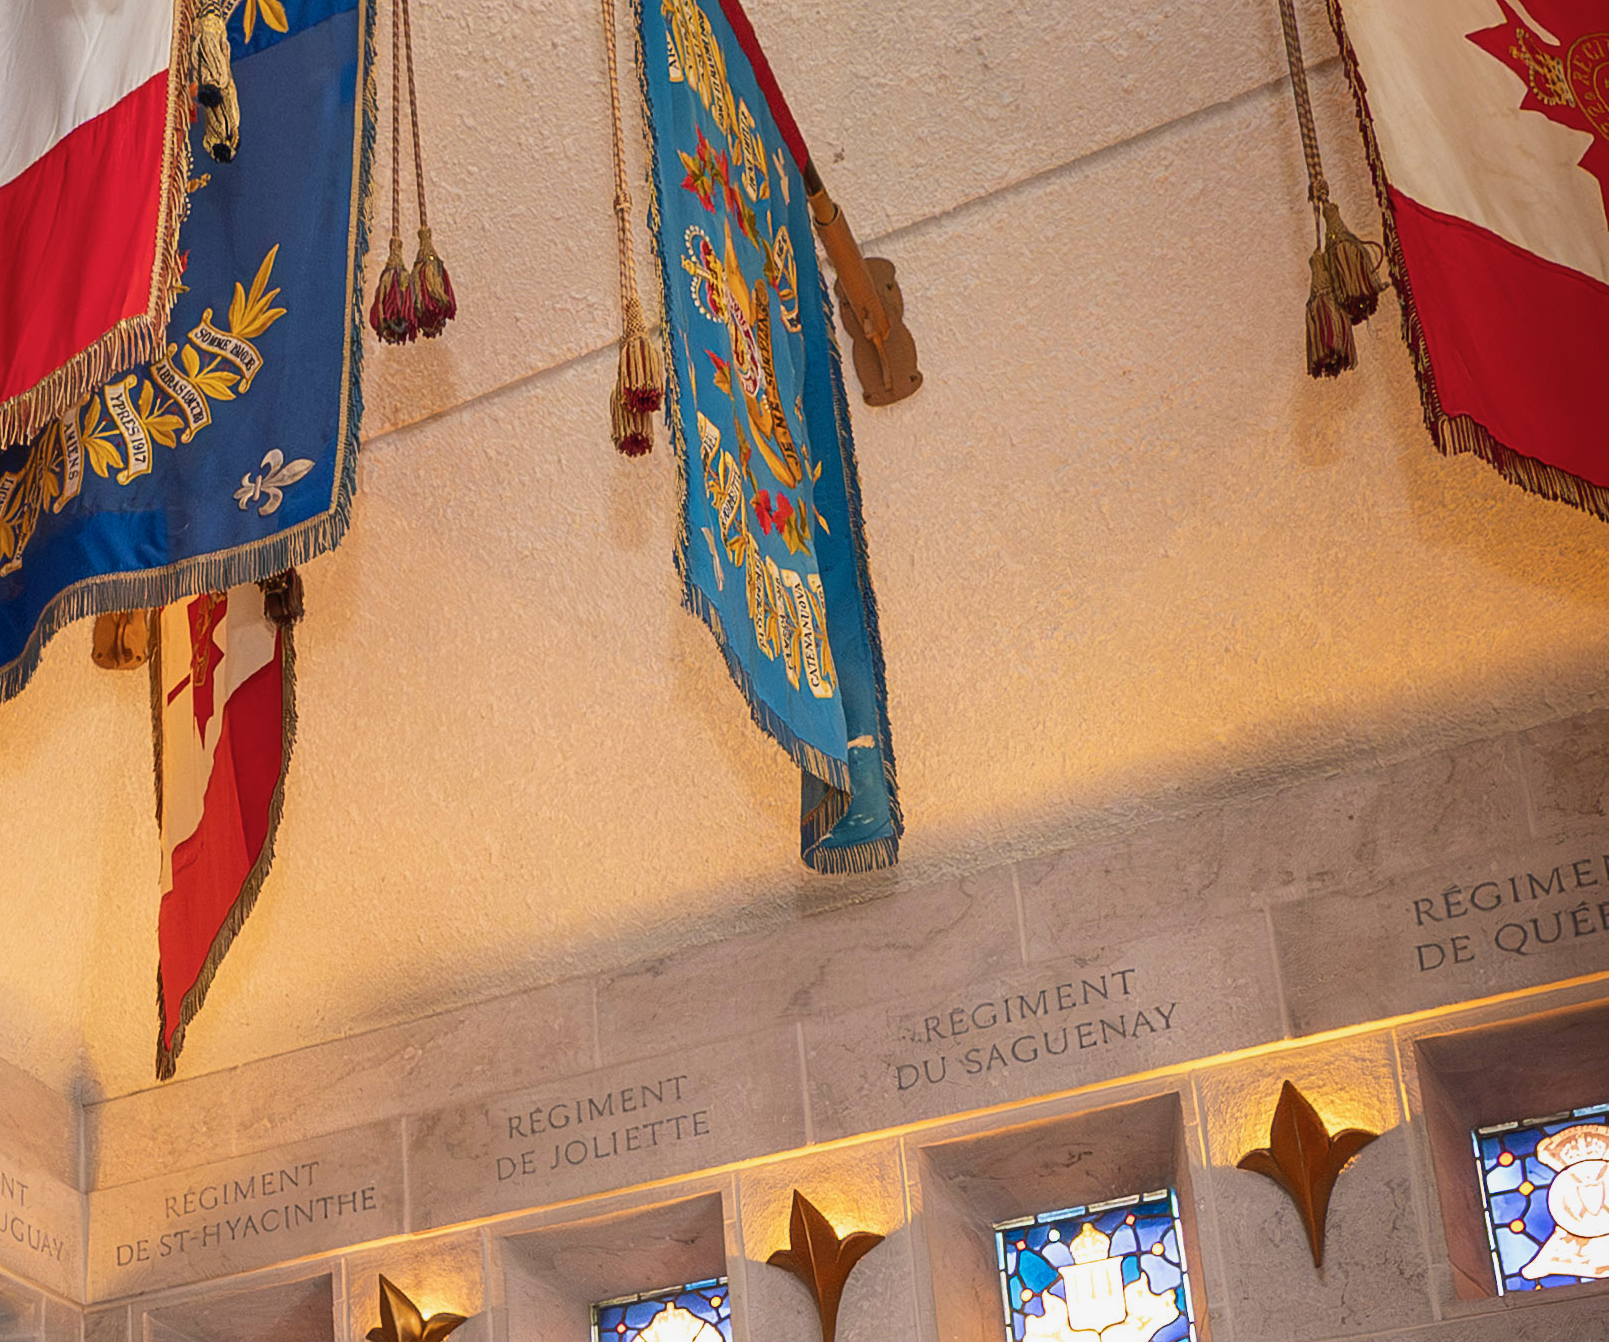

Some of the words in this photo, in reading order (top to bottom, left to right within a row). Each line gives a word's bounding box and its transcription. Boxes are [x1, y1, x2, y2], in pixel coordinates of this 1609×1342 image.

[194, 327, 231, 351] SOMME
[63, 421, 80, 482] AMIENS
[110, 392, 141, 437] YPRES
[132, 435, 147, 464] 1917
[794, 582, 821, 688] CATENANUOVA
[1412, 854, 1609, 927] RÉGIME
[1414, 934, 1476, 972] DE
[895, 1055, 947, 1091] DU
[964, 1001, 1177, 1076] SAGUENAY
[495, 1149, 537, 1182] DE
[549, 1109, 711, 1171] JOLIETTE
[115, 1239, 150, 1268] DE
[159, 1185, 378, 1258] ST-HYACINTHE
